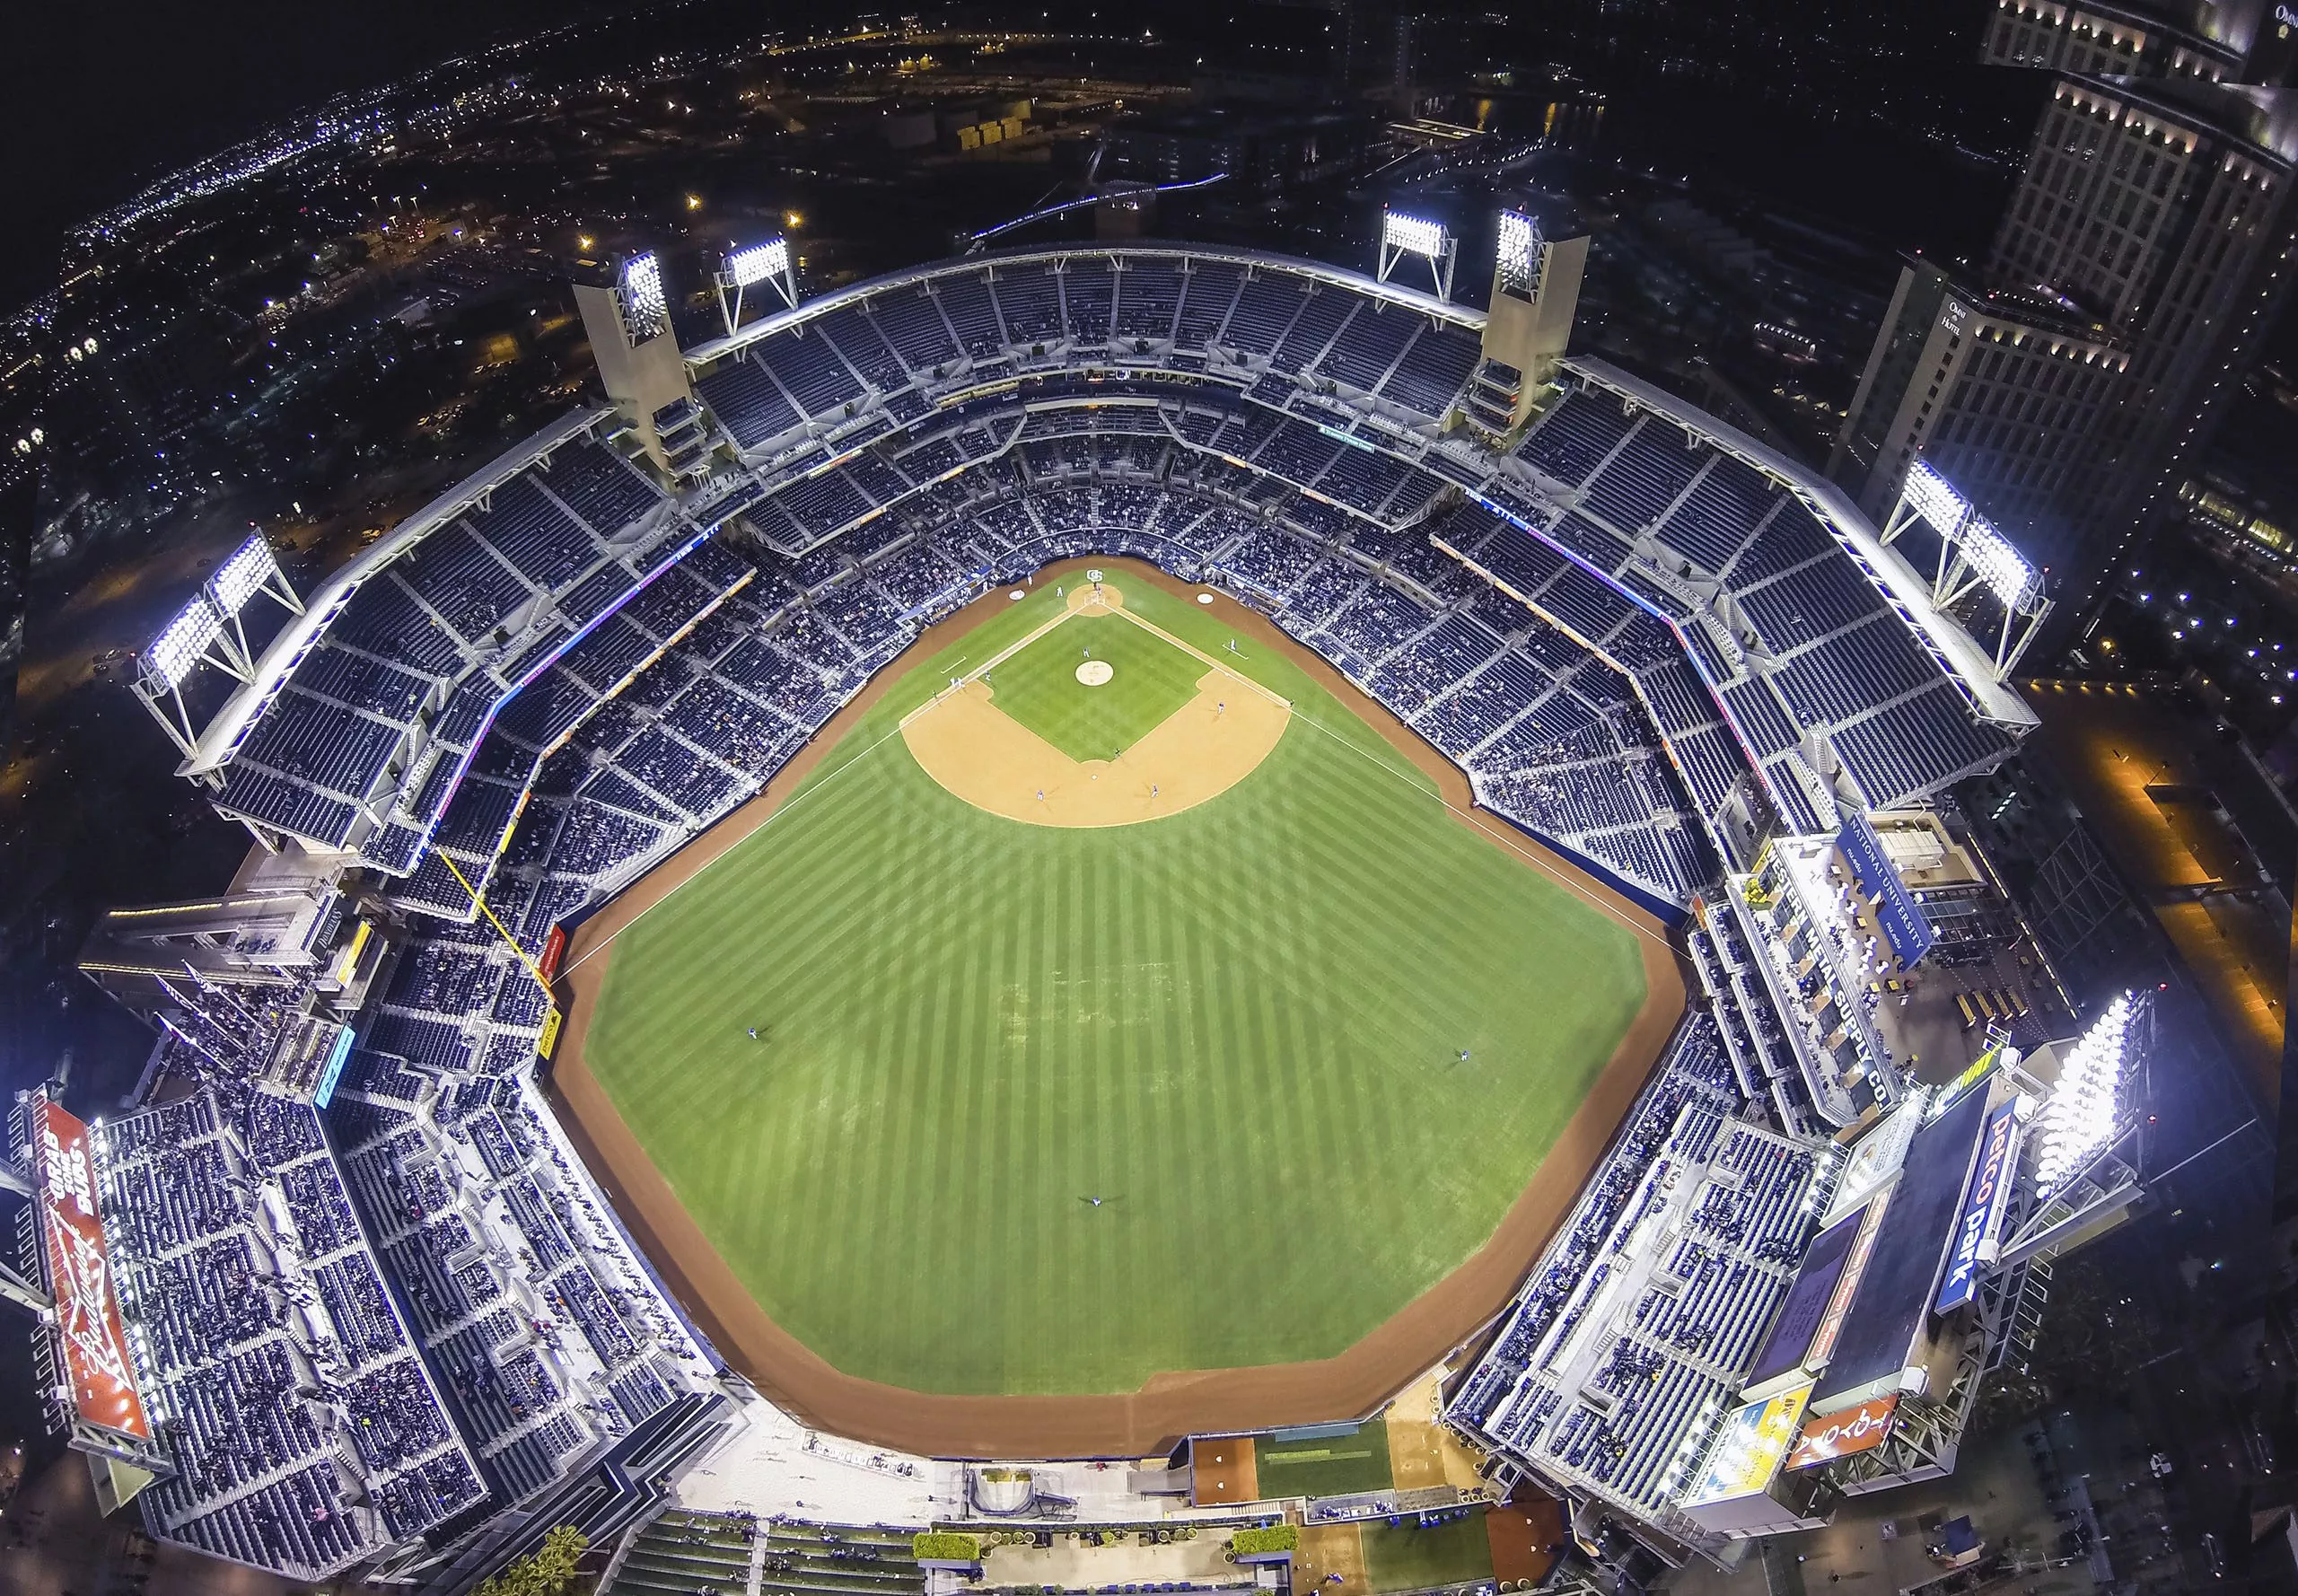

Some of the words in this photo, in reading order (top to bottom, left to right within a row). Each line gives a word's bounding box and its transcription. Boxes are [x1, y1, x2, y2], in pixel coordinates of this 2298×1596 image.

[1941, 316, 1960, 336] HOTEL
[1846, 847, 1863, 873] nu.edu
[1850, 819, 1883, 878] NATIONAL
[1882, 876, 1925, 950] UNIVERSITY
[1885, 921, 1902, 950] nu.edu
[1765, 844, 1809, 927] WESTERN
[1805, 927, 1837, 992] METAL
[1834, 990, 1873, 1064] SUPPLY
[1868, 1070, 1887, 1109] CO.
[43, 1122, 66, 1200] GRAB
[59, 1149, 75, 1196] SOME
[70, 1146, 94, 1216] BUDS
[1975, 1111, 2012, 1206] petco
[1948, 1204, 1987, 1289] park
[70, 1223, 110, 1375] Budweiser
